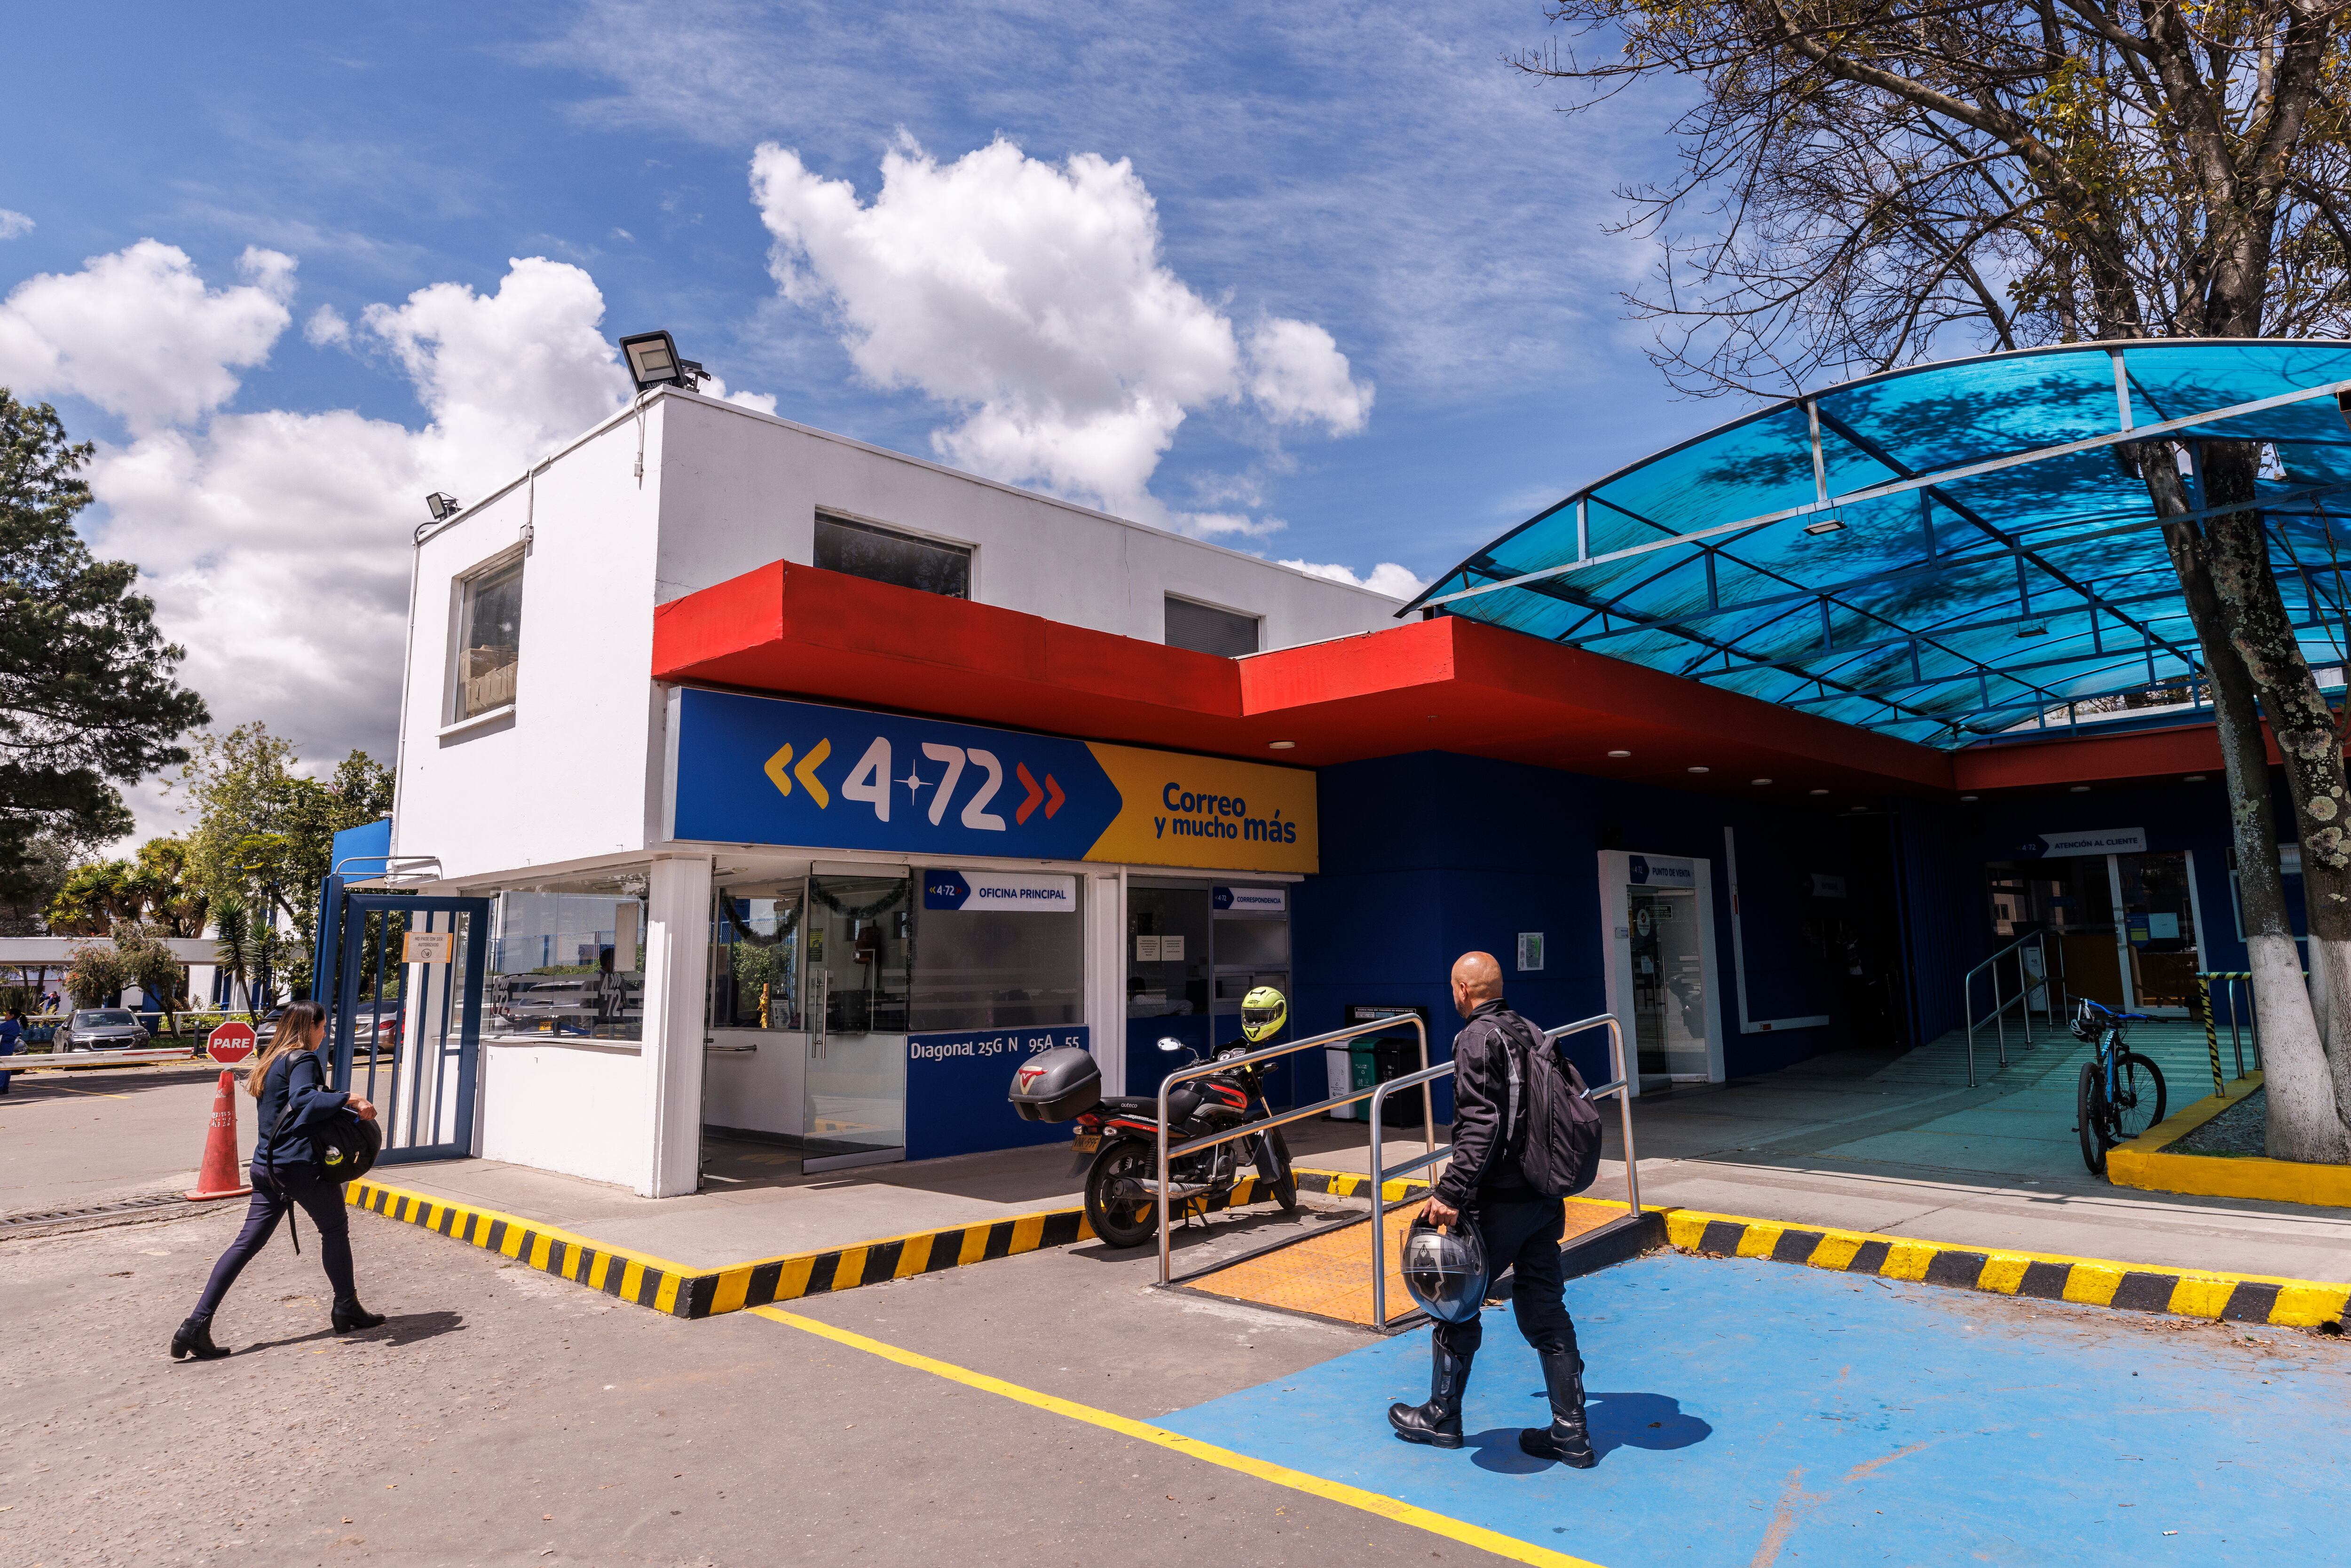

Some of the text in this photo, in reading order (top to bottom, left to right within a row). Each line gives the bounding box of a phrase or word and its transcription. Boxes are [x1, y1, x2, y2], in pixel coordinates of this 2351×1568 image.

[1163, 782, 1246, 818] Correo
[1154, 809, 1297, 844] y mucho más
[2054, 840, 2092, 850] ATENCIÓN
[2106, 837, 2138, 846] CLIENTE
[1652, 867, 1668, 876] PUNTO
[979, 888, 1066, 899] OFICINA PRINCIPAL
[213, 1038, 250, 1048] PARE
[978, 1038, 1002, 1056] 25G
[1009, 1037, 1018, 1052] N
[1029, 1034, 1054, 1053] 95A
[1065, 1037, 1079, 1048] 55
[2102, 1030, 2115, 1052] TRITON
